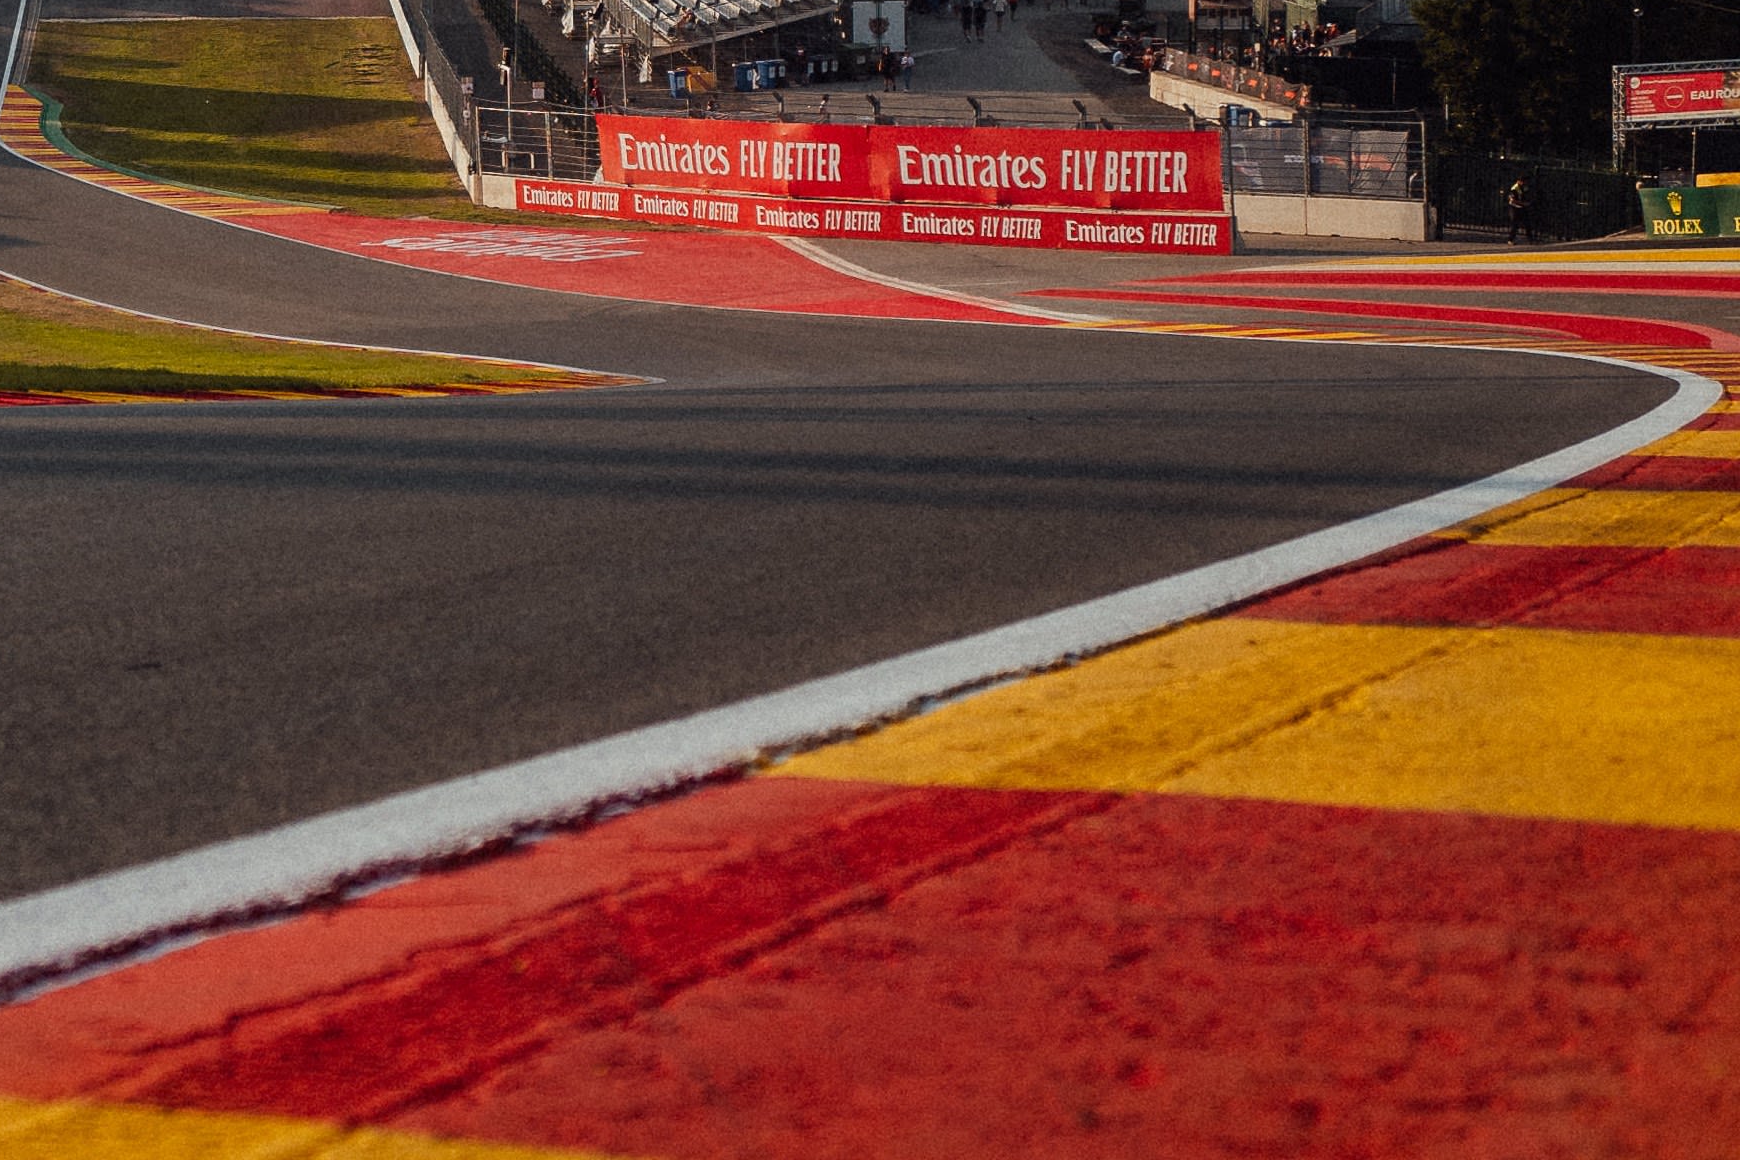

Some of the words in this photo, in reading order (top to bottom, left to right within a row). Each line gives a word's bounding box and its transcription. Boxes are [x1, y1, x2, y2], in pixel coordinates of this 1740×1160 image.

[1690, 90, 1714, 101] EAU
[618, 132, 731, 176] Emirates
[740, 139, 768, 179] FLY
[772, 142, 841, 182] BETTER
[897, 144, 1047, 189] Emirates
[1061, 149, 1097, 191] FLY
[1104, 150, 1188, 193] BETTER
[523, 185, 574, 208] Emirates
[577, 190, 590, 210] FLY
[591, 191, 620, 212] BETTER
[634, 194, 689, 218] Emirates
[693, 199, 707, 220] FLY
[708, 201, 739, 224] BETTER
[755, 204, 820, 230] Emirates
[825, 209, 842, 231] FLY
[843, 210, 881, 233] BETTER
[902, 212, 974, 237] Emirates
[980, 215, 999, 238] FLY
[1001, 216, 1042, 240] BETTER
[1065, 220, 1145, 245] Emirates
[1151, 221, 1172, 246] FLY
[1173, 223, 1217, 247] BETTER
[1652, 219, 1704, 235] ROLEX
